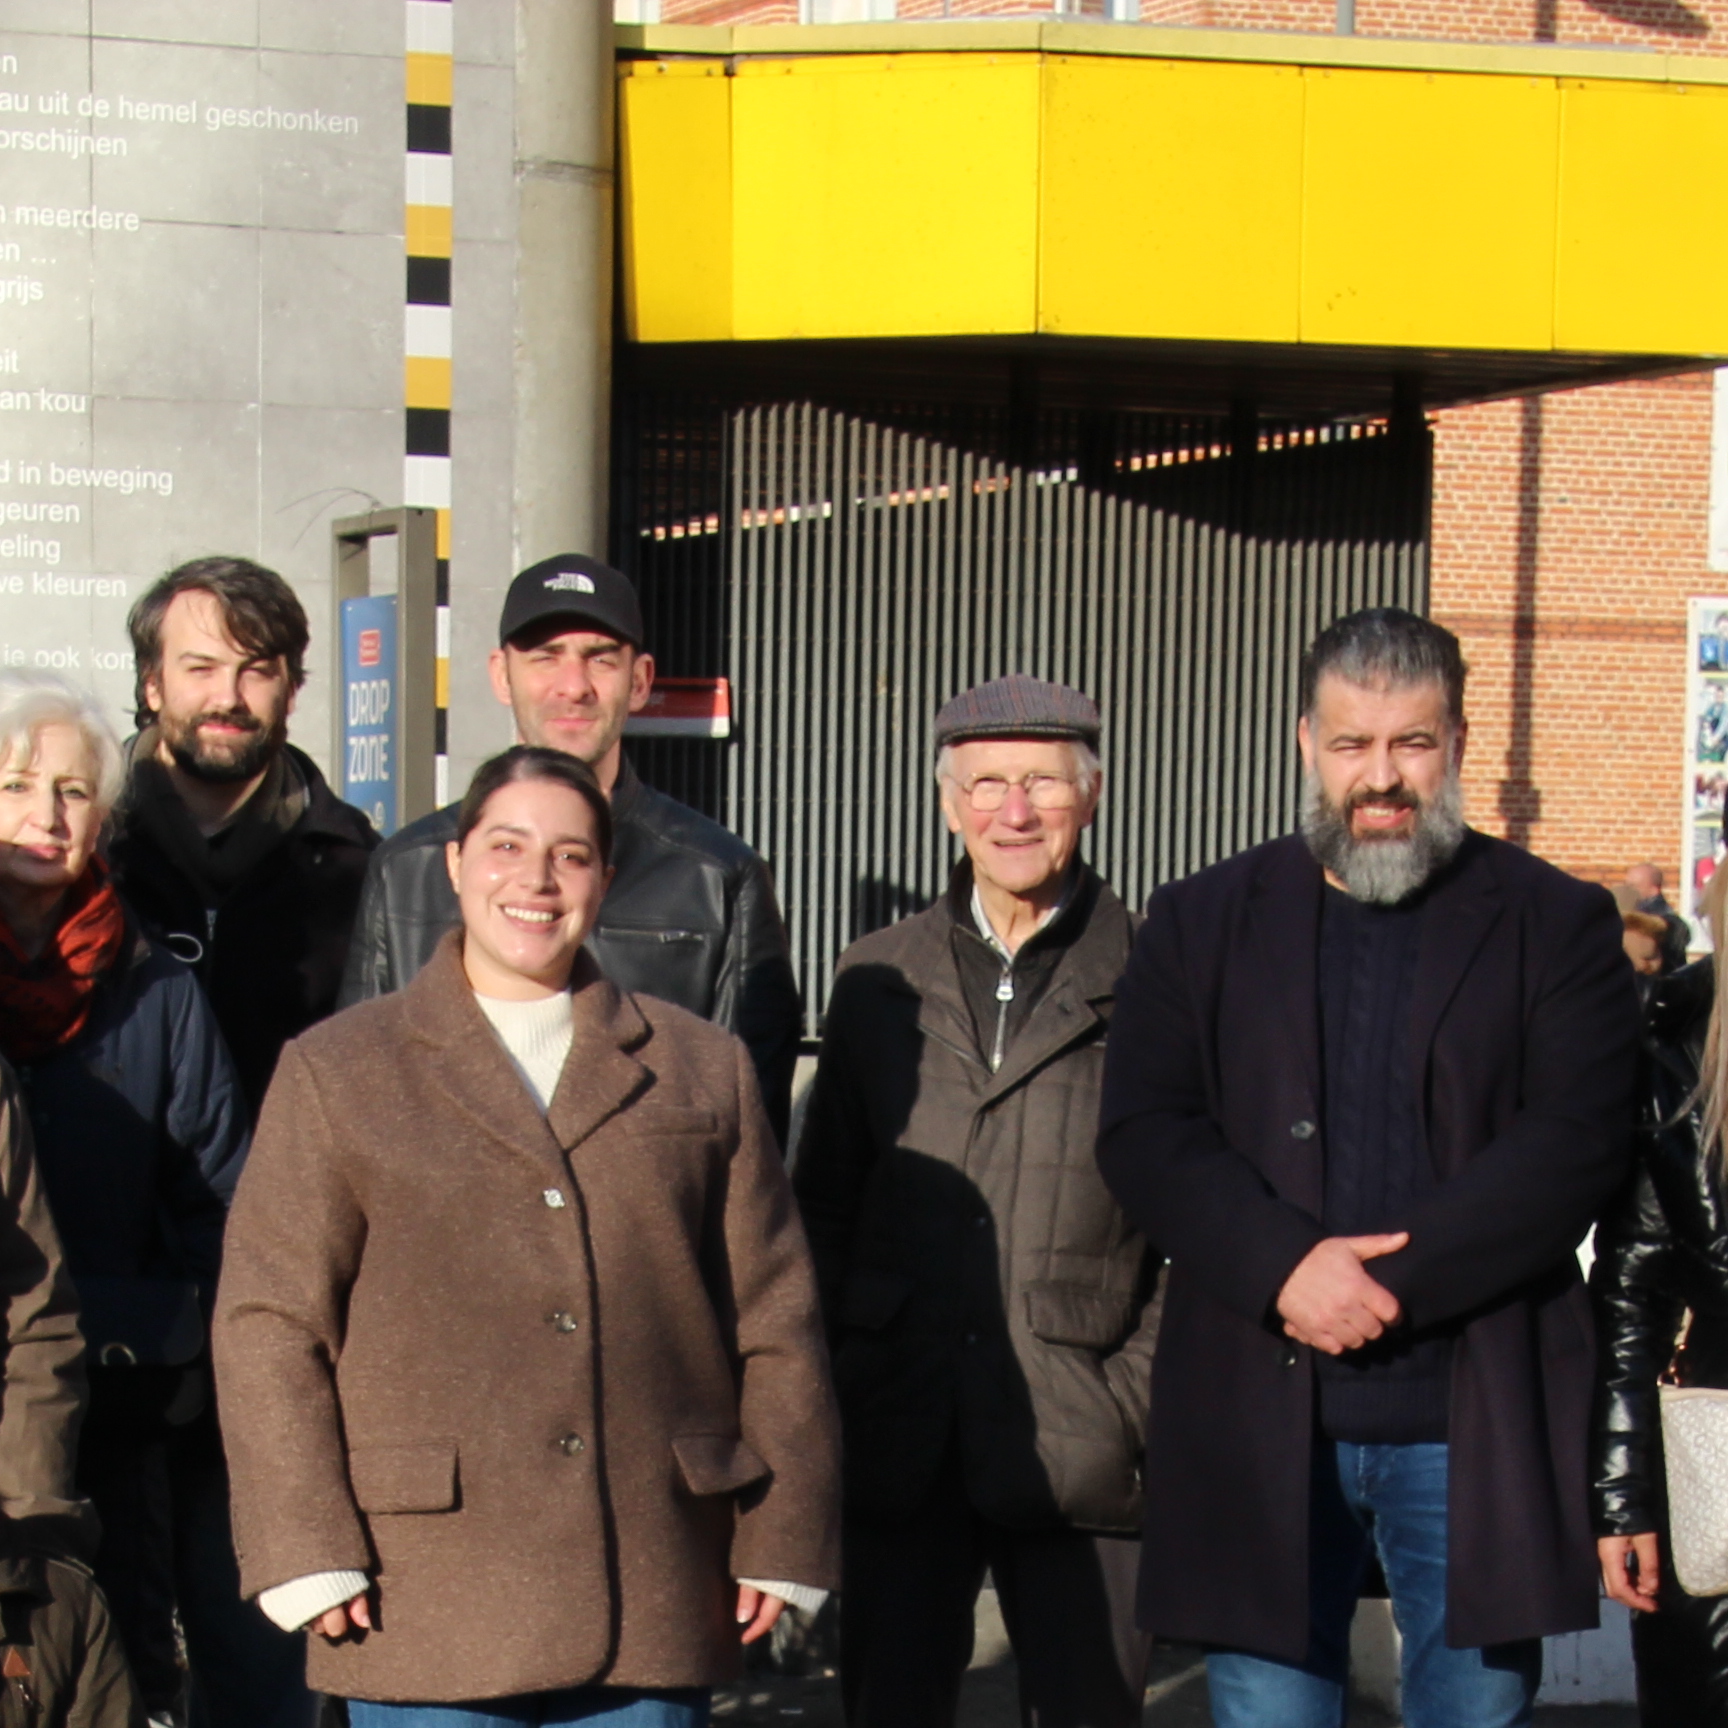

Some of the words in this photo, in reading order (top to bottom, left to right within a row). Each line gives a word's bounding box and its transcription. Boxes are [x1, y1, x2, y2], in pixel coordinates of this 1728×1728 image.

[37, 90, 70, 114] uit
[76, 92, 110, 117] de
[118, 95, 196, 123] hemel
[204, 105, 358, 133] geschonken
[15, 205, 138, 231] meerdere
[39, 388, 87, 412] kou
[18, 459, 41, 483] in
[49, 461, 174, 494] beweging
[31, 570, 127, 596] kleuren
[33, 645, 80, 668] ook
[349, 679, 390, 727] DROP
[348, 734, 390, 783] ZONE
